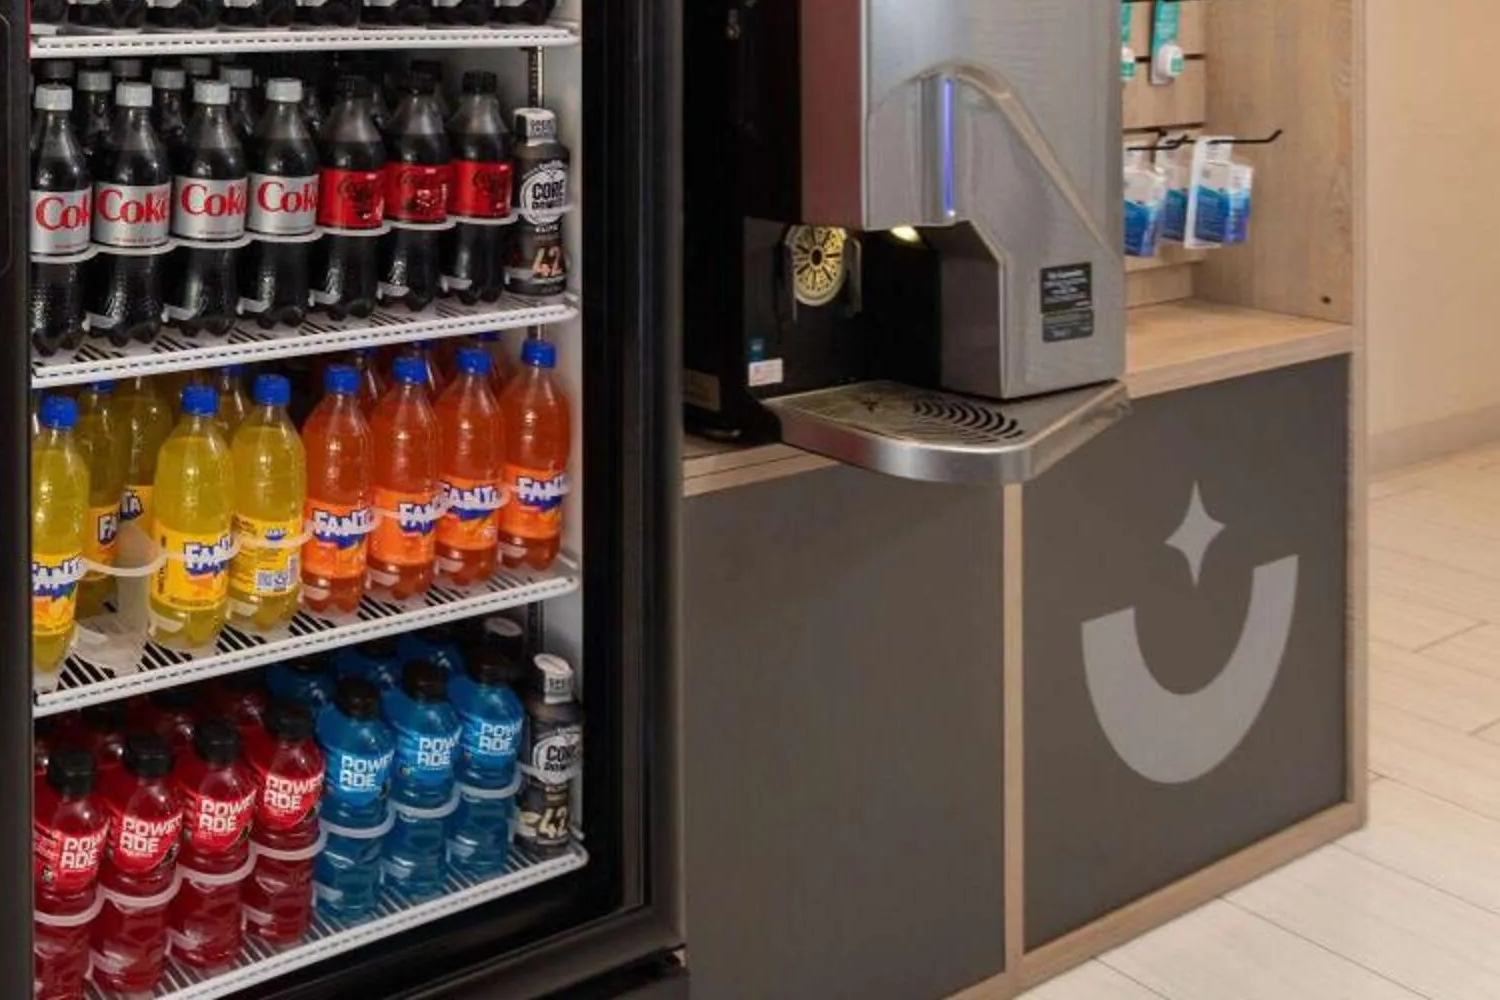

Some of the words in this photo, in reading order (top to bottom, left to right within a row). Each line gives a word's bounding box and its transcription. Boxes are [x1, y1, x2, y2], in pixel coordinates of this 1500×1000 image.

[532, 246, 564, 277] 42
[264, 790, 302, 810] ADE
[199, 813, 237, 833] ADE
[120, 832, 160, 854] ADE
